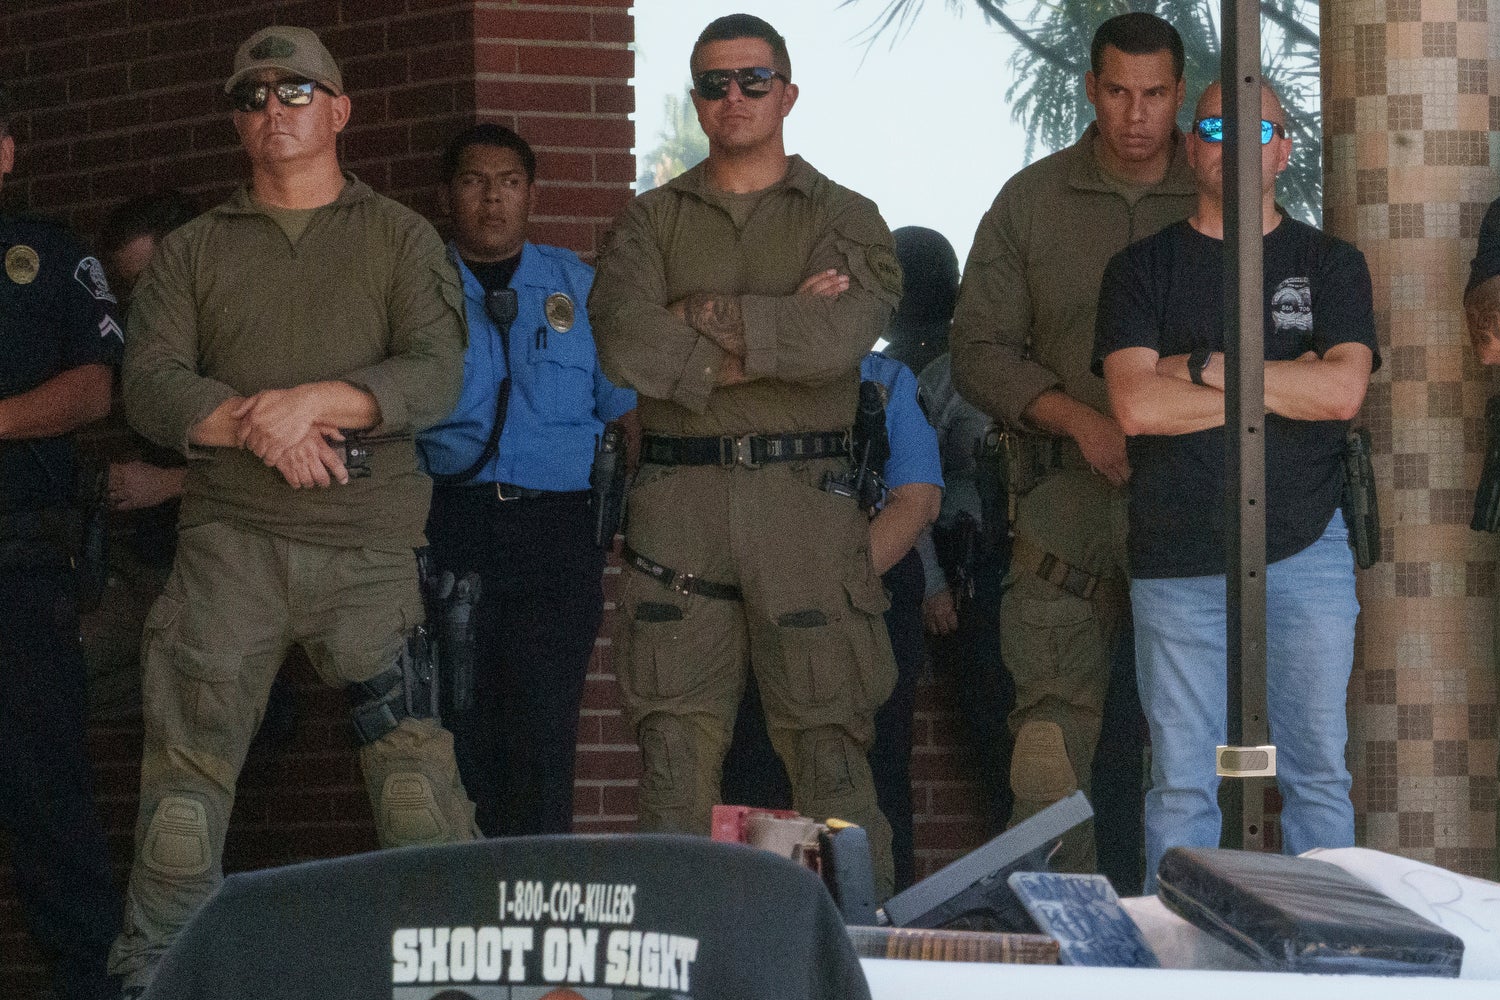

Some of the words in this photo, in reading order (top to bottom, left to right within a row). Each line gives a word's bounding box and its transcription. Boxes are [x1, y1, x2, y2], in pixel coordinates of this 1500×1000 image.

[499, 880, 637, 924] 1-800-COP-KILLERS
[392, 926, 533, 985] SHOOT
[543, 927, 599, 985] ON
[603, 929, 699, 992] SIGHT
